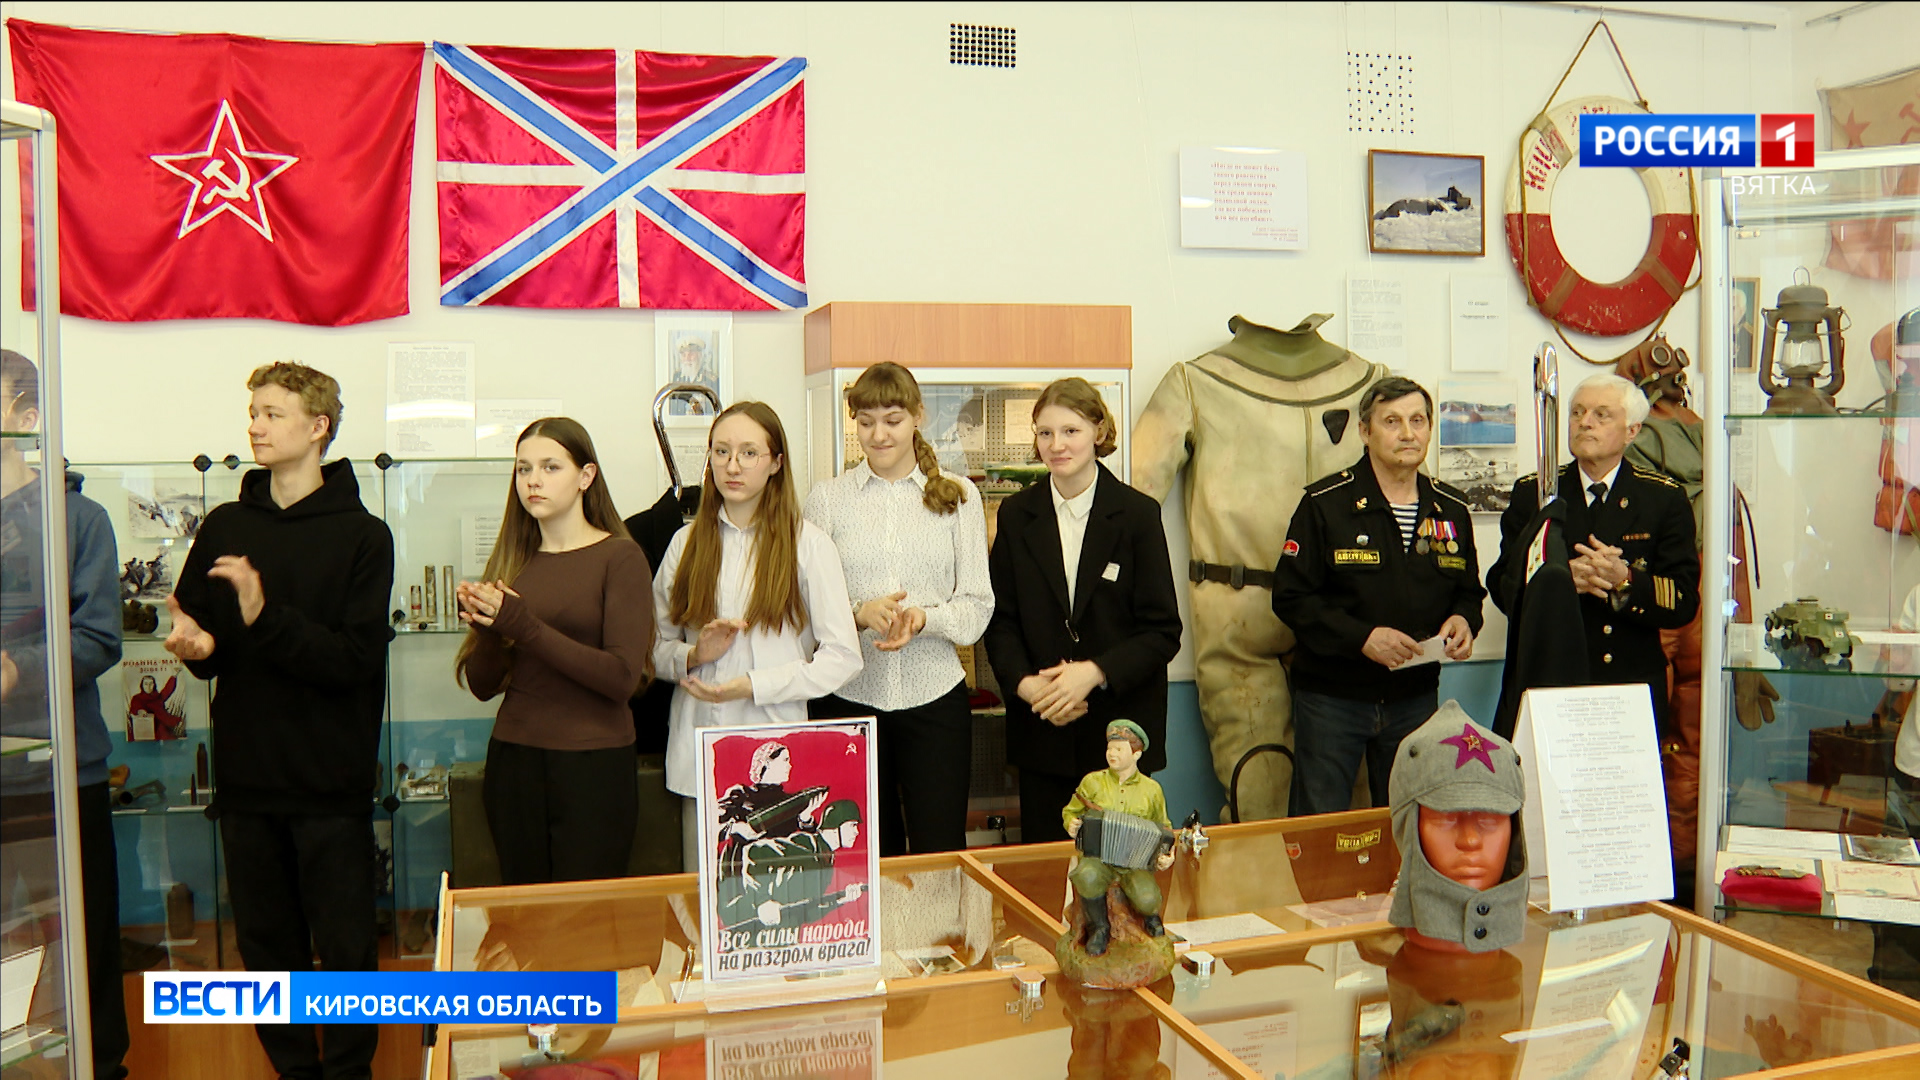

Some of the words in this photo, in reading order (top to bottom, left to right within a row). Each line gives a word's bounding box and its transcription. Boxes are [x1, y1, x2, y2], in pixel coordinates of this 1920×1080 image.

[720, 930, 751, 951] Все
[756, 926, 800, 947] силы
[719, 954, 739, 971] на
[743, 946, 813, 970] разгром
[818, 938, 871, 961] врага!
